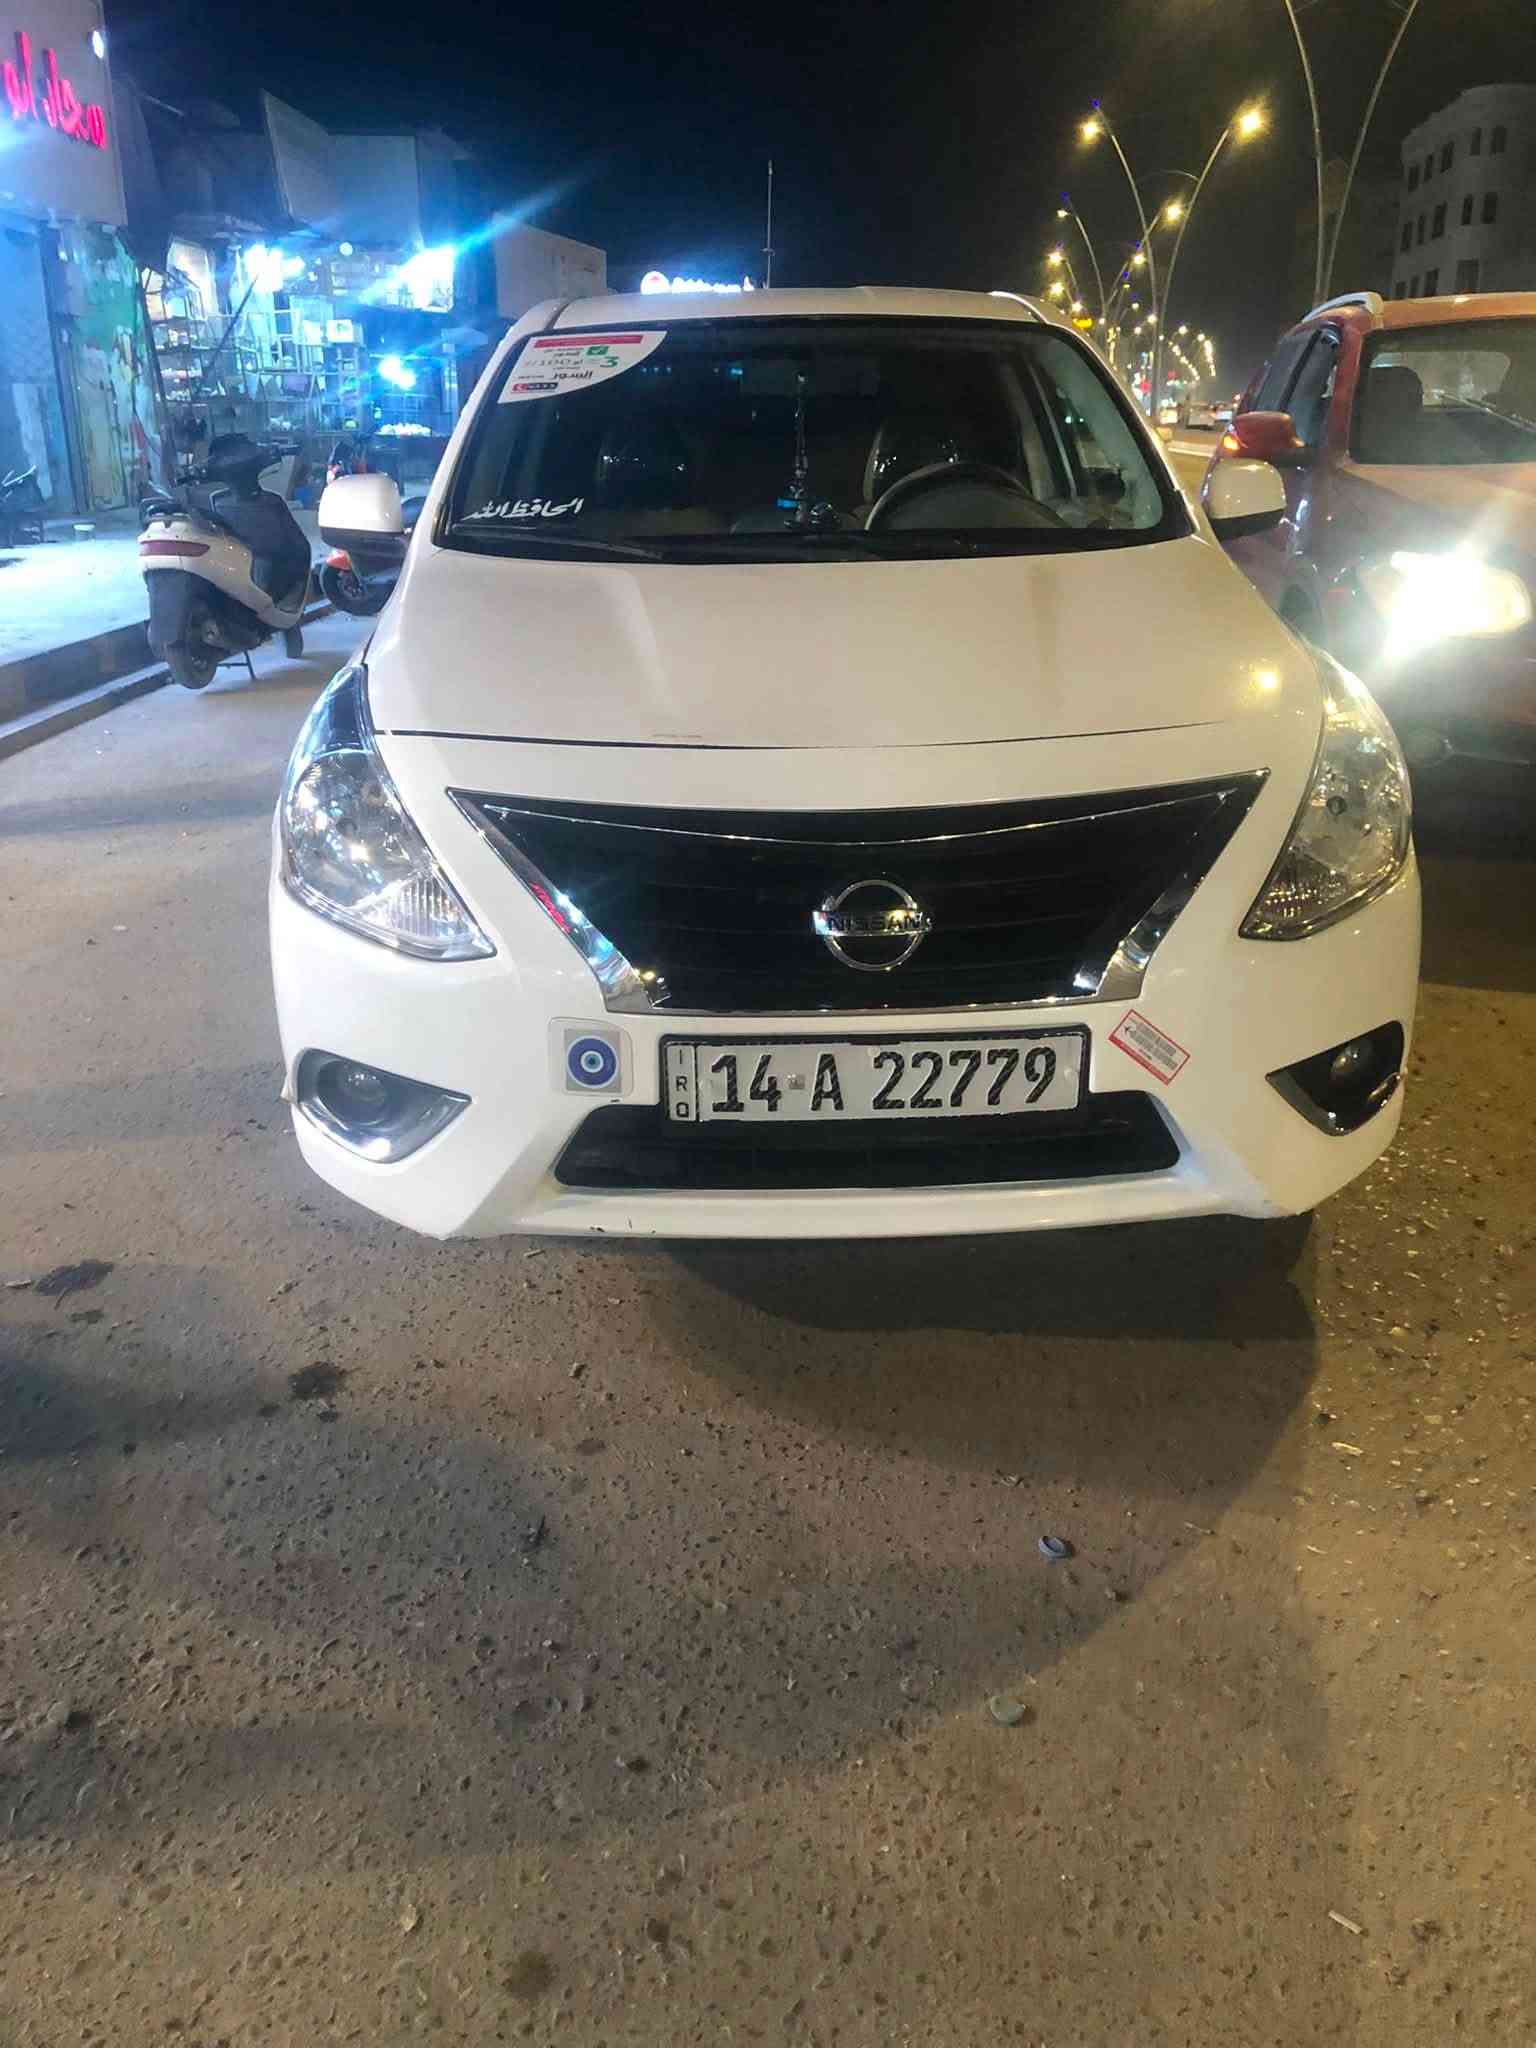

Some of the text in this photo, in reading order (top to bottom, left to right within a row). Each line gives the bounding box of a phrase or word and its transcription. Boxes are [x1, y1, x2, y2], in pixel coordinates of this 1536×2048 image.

[829, 911, 925, 931] NISSAN
[711, 1046, 1057, 1113] 14 A 22779
